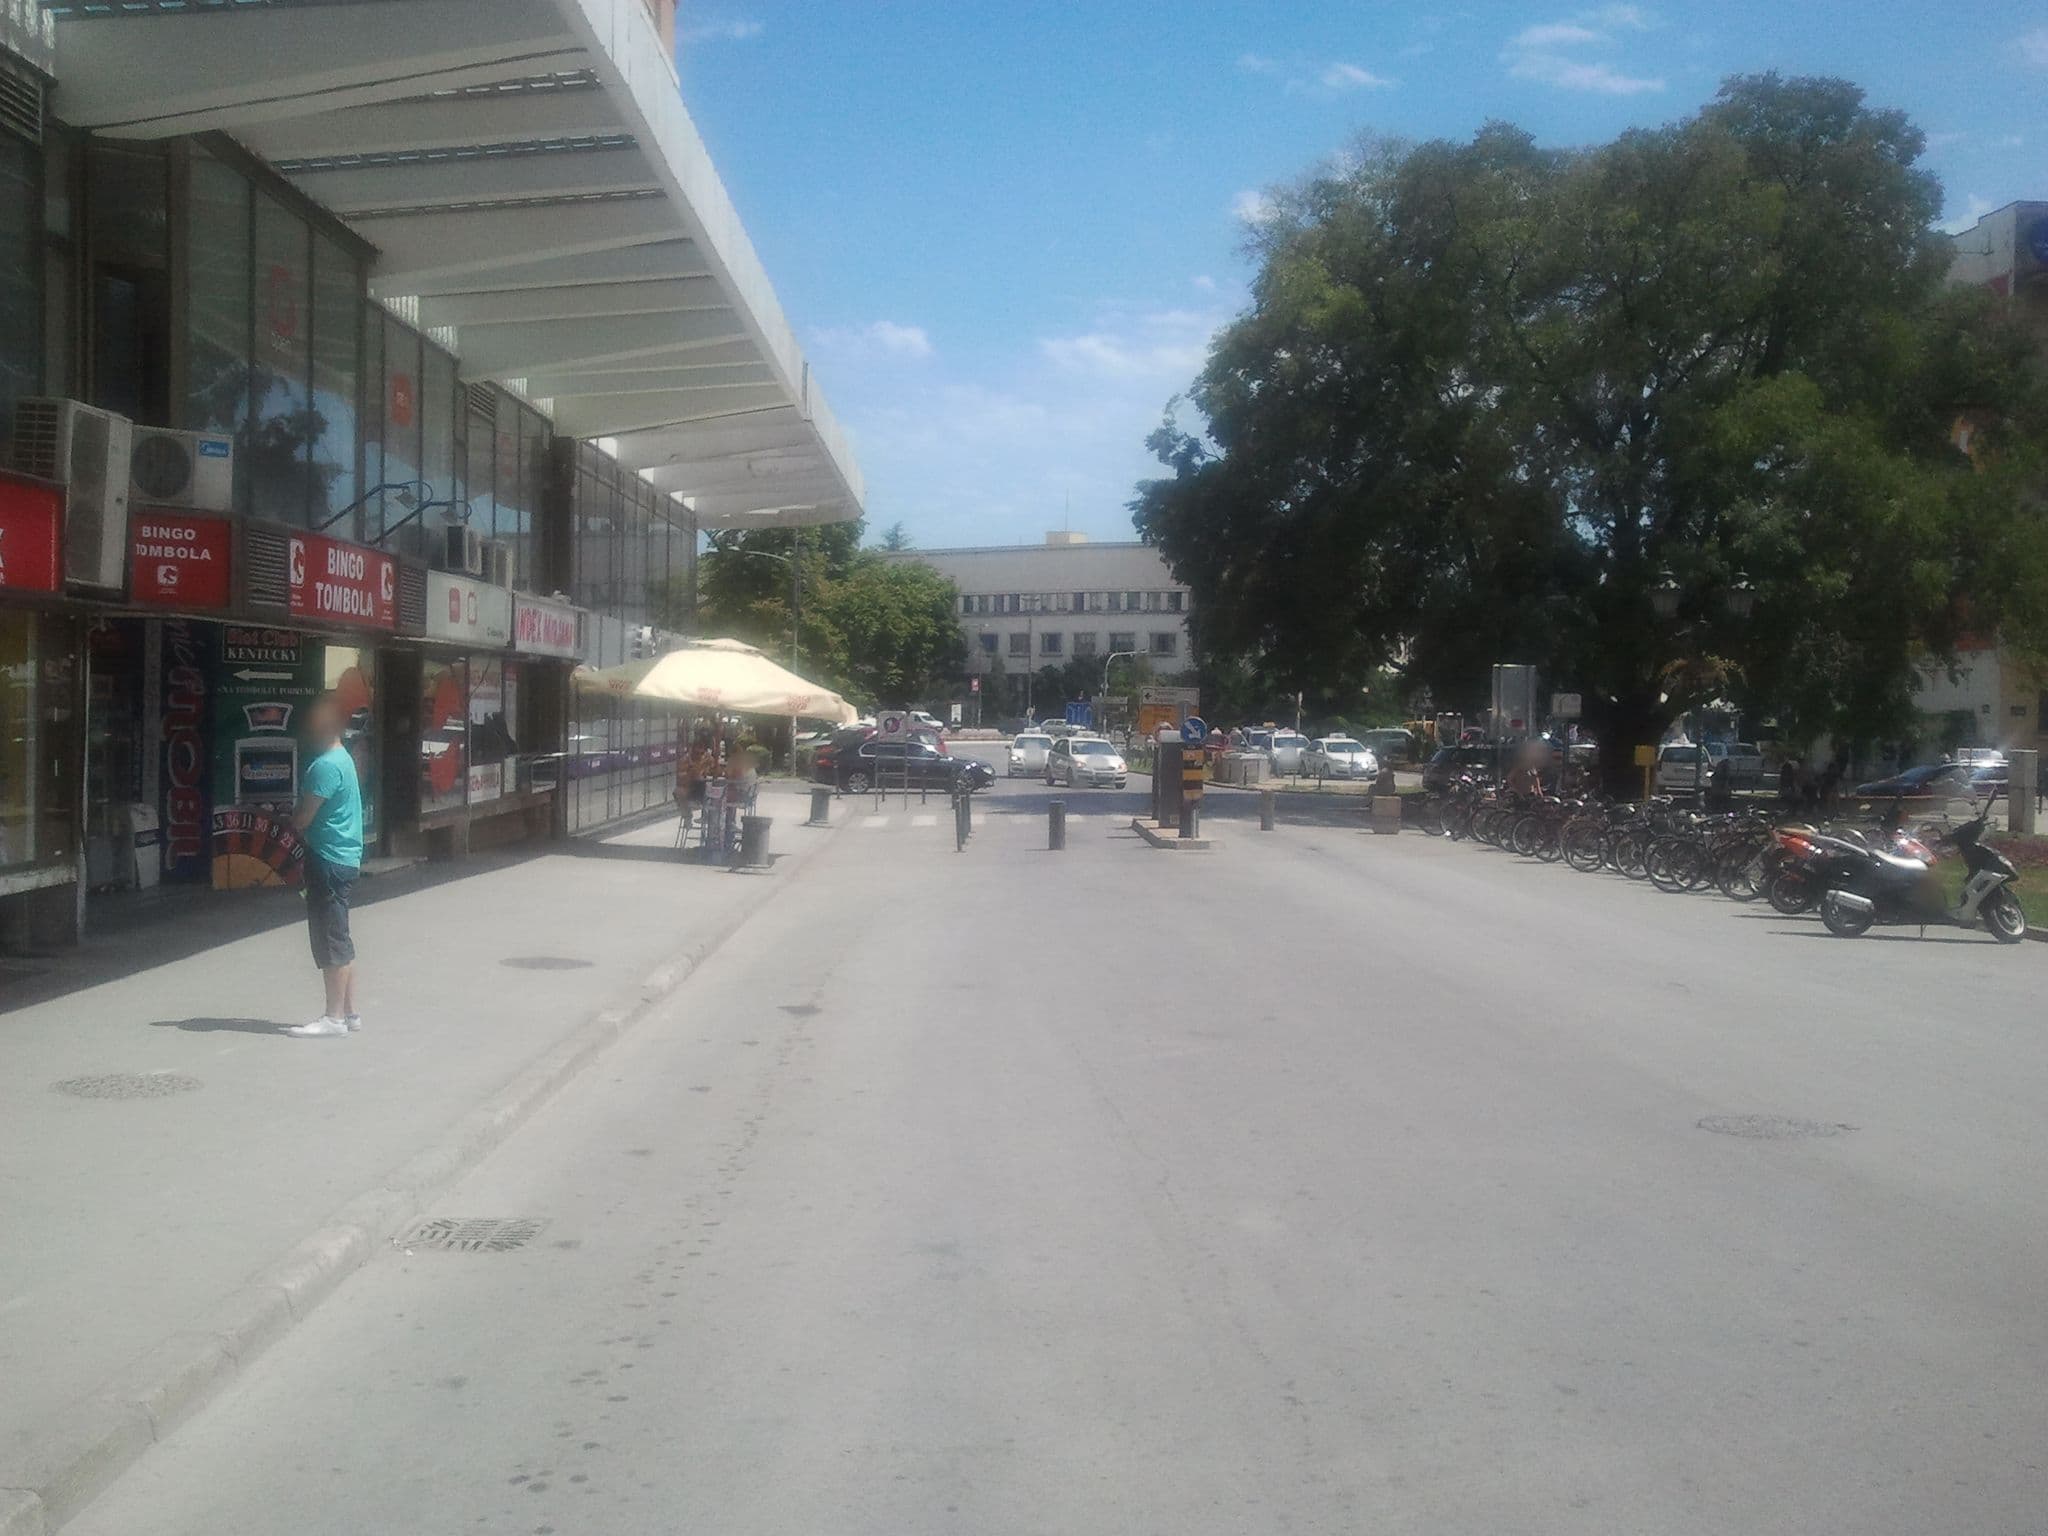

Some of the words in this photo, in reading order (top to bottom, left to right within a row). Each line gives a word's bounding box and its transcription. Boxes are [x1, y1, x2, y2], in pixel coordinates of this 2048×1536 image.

[142, 526, 196, 541] BINGO
[136, 544, 212, 561] TOMBOLA
[327, 547, 364, 581] BINGO
[315, 582, 374, 617] TOMBOLA
[227, 647, 297, 662] KENTUCKY
